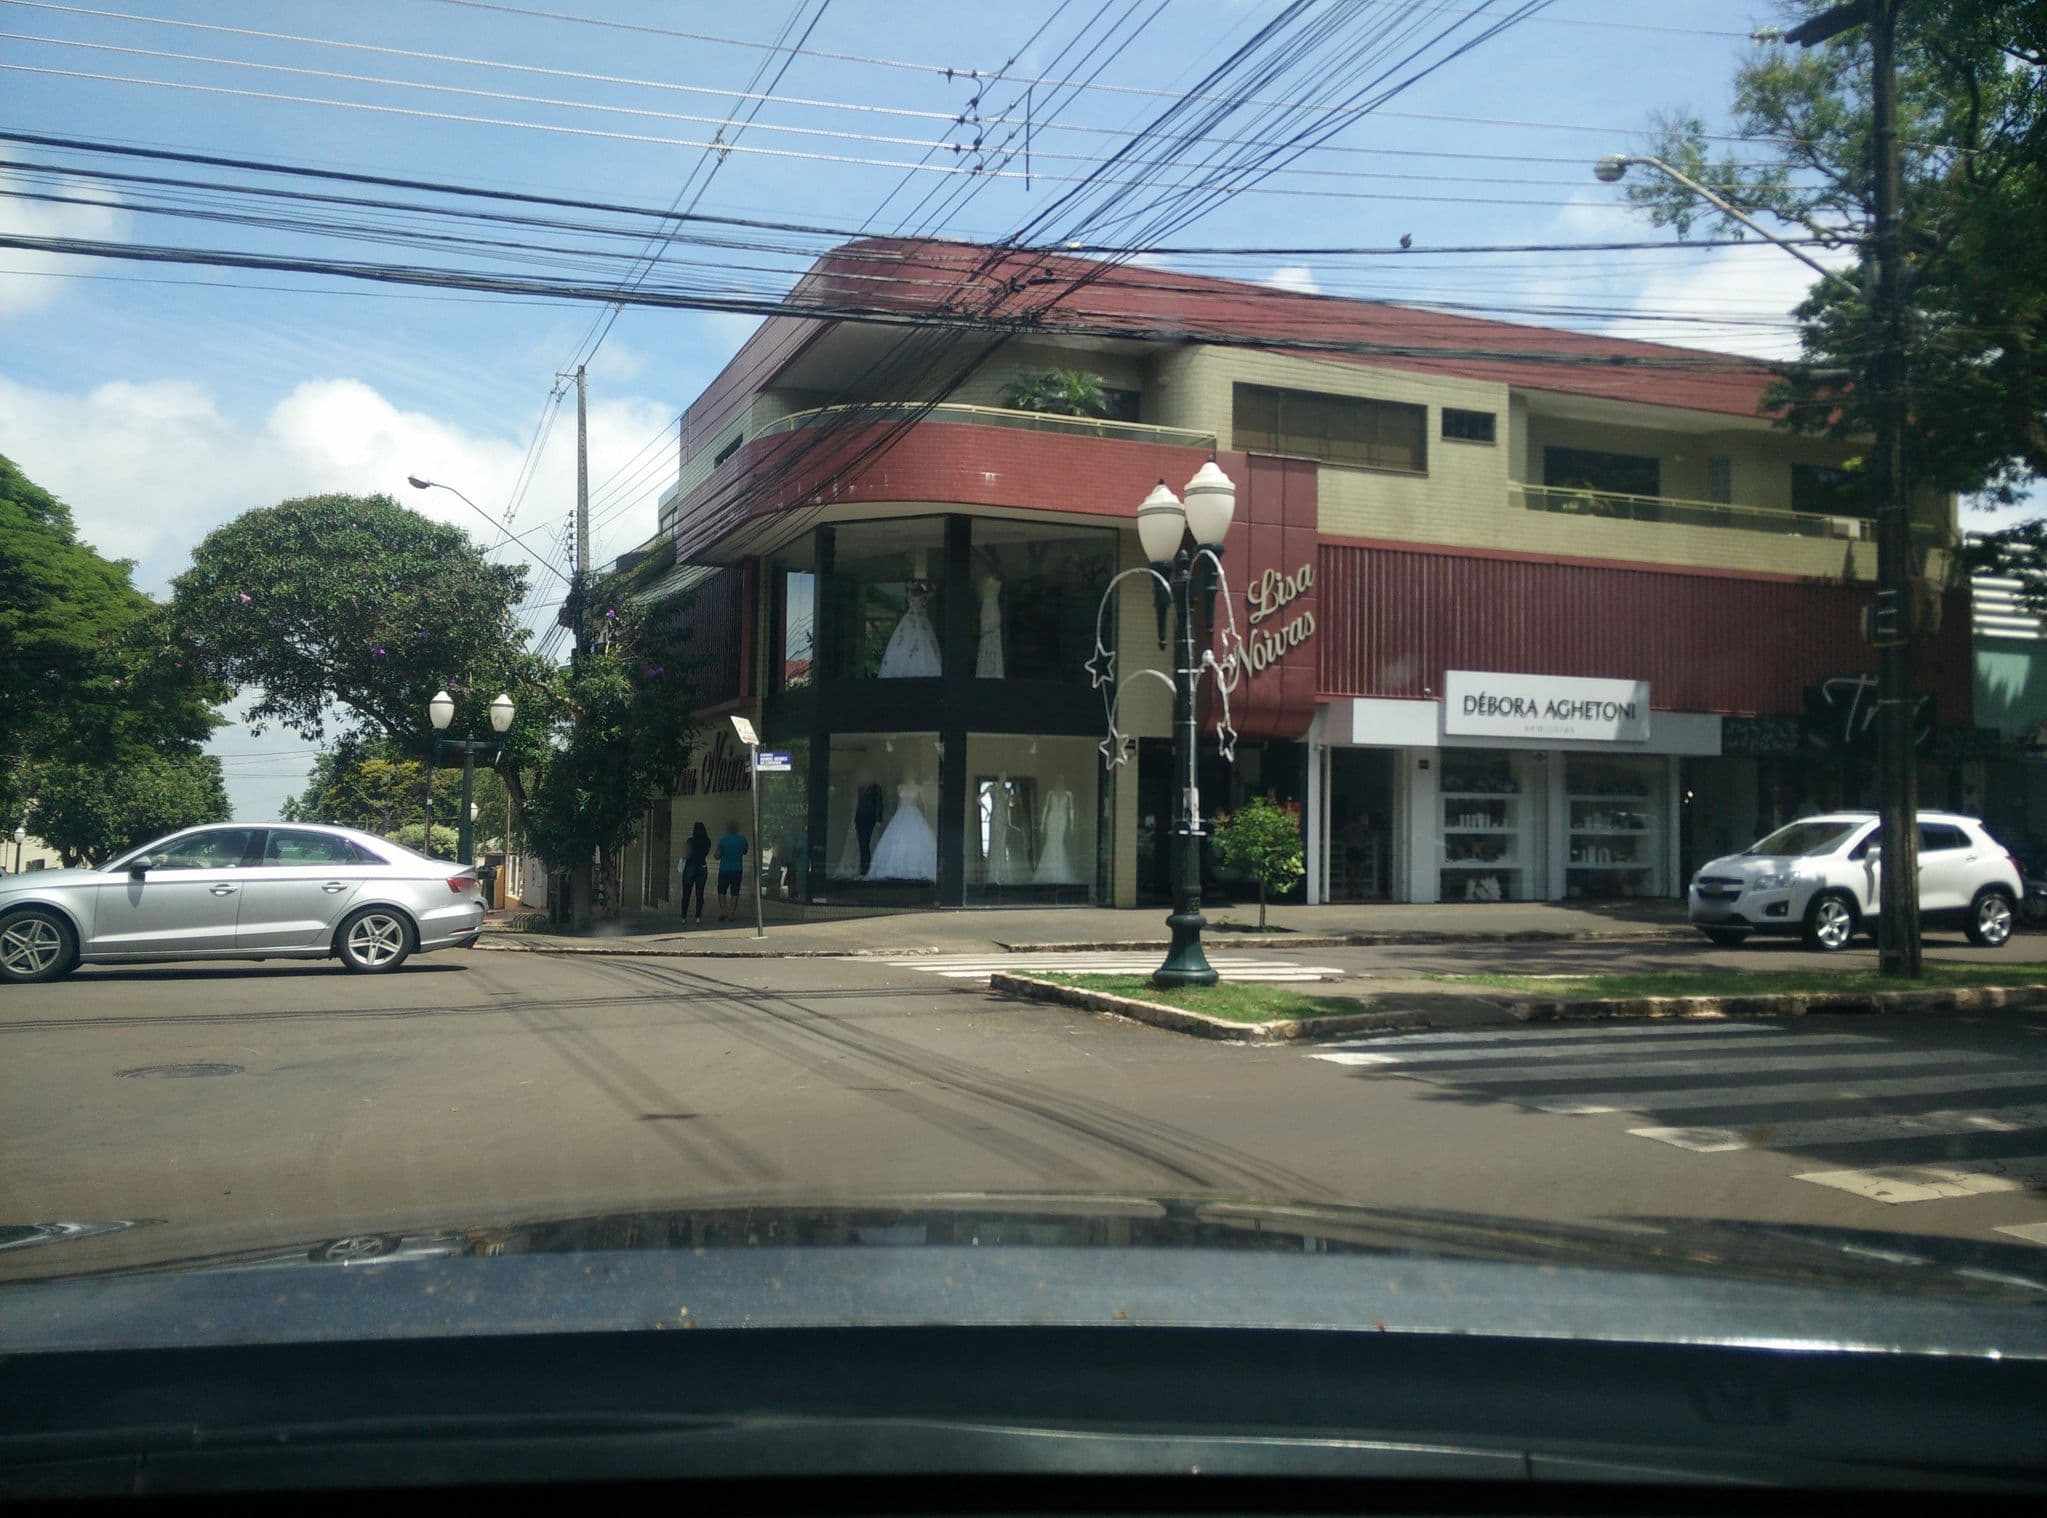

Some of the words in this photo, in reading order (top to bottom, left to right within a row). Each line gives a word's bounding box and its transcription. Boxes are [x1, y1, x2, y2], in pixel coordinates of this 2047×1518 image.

[1248, 563, 1315, 624] Lisa
[1218, 611, 1316, 694] Noivas
[1464, 692, 1539, 717] DÉBORA
[1545, 699, 1636, 722] AGHETONI
